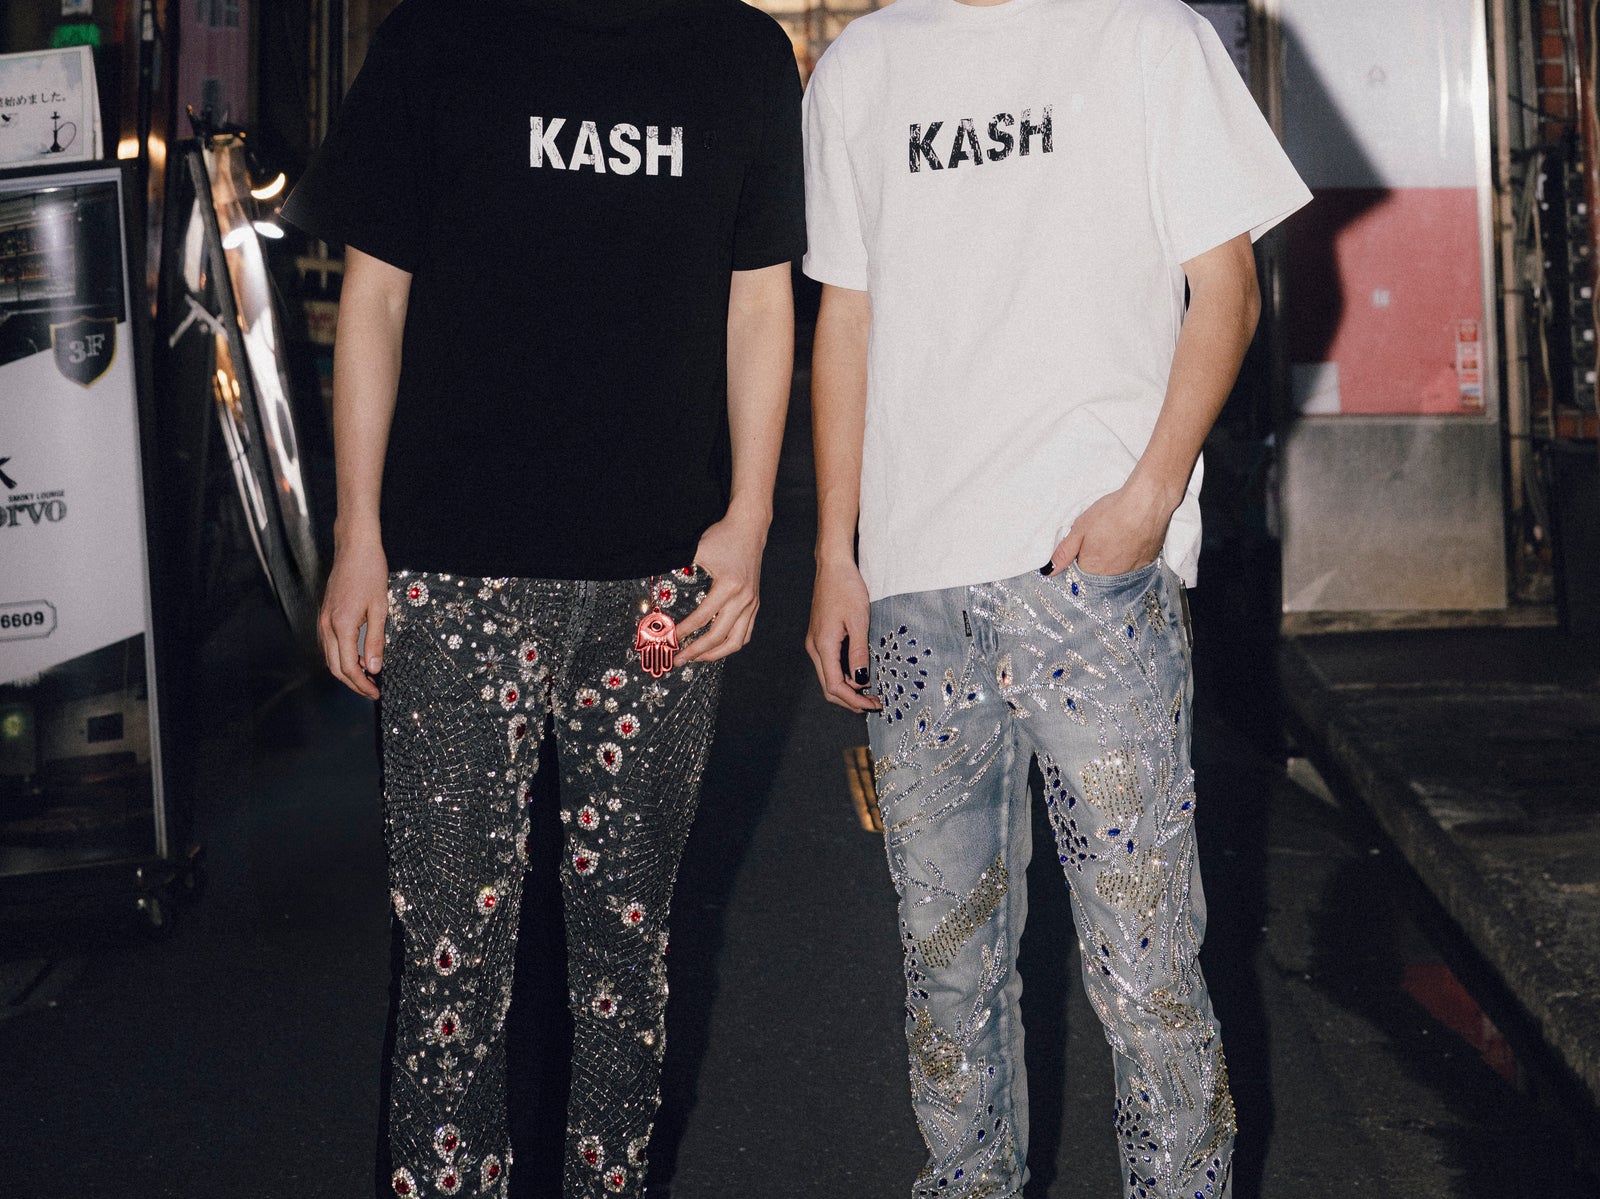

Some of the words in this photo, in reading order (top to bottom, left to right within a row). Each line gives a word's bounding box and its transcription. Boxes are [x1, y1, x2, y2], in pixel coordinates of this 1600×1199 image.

[529, 115, 684, 177] KASH
[907, 103, 1054, 174] KASH
[68, 333, 106, 364] 3F
[0, 611, 45, 630] 6609
